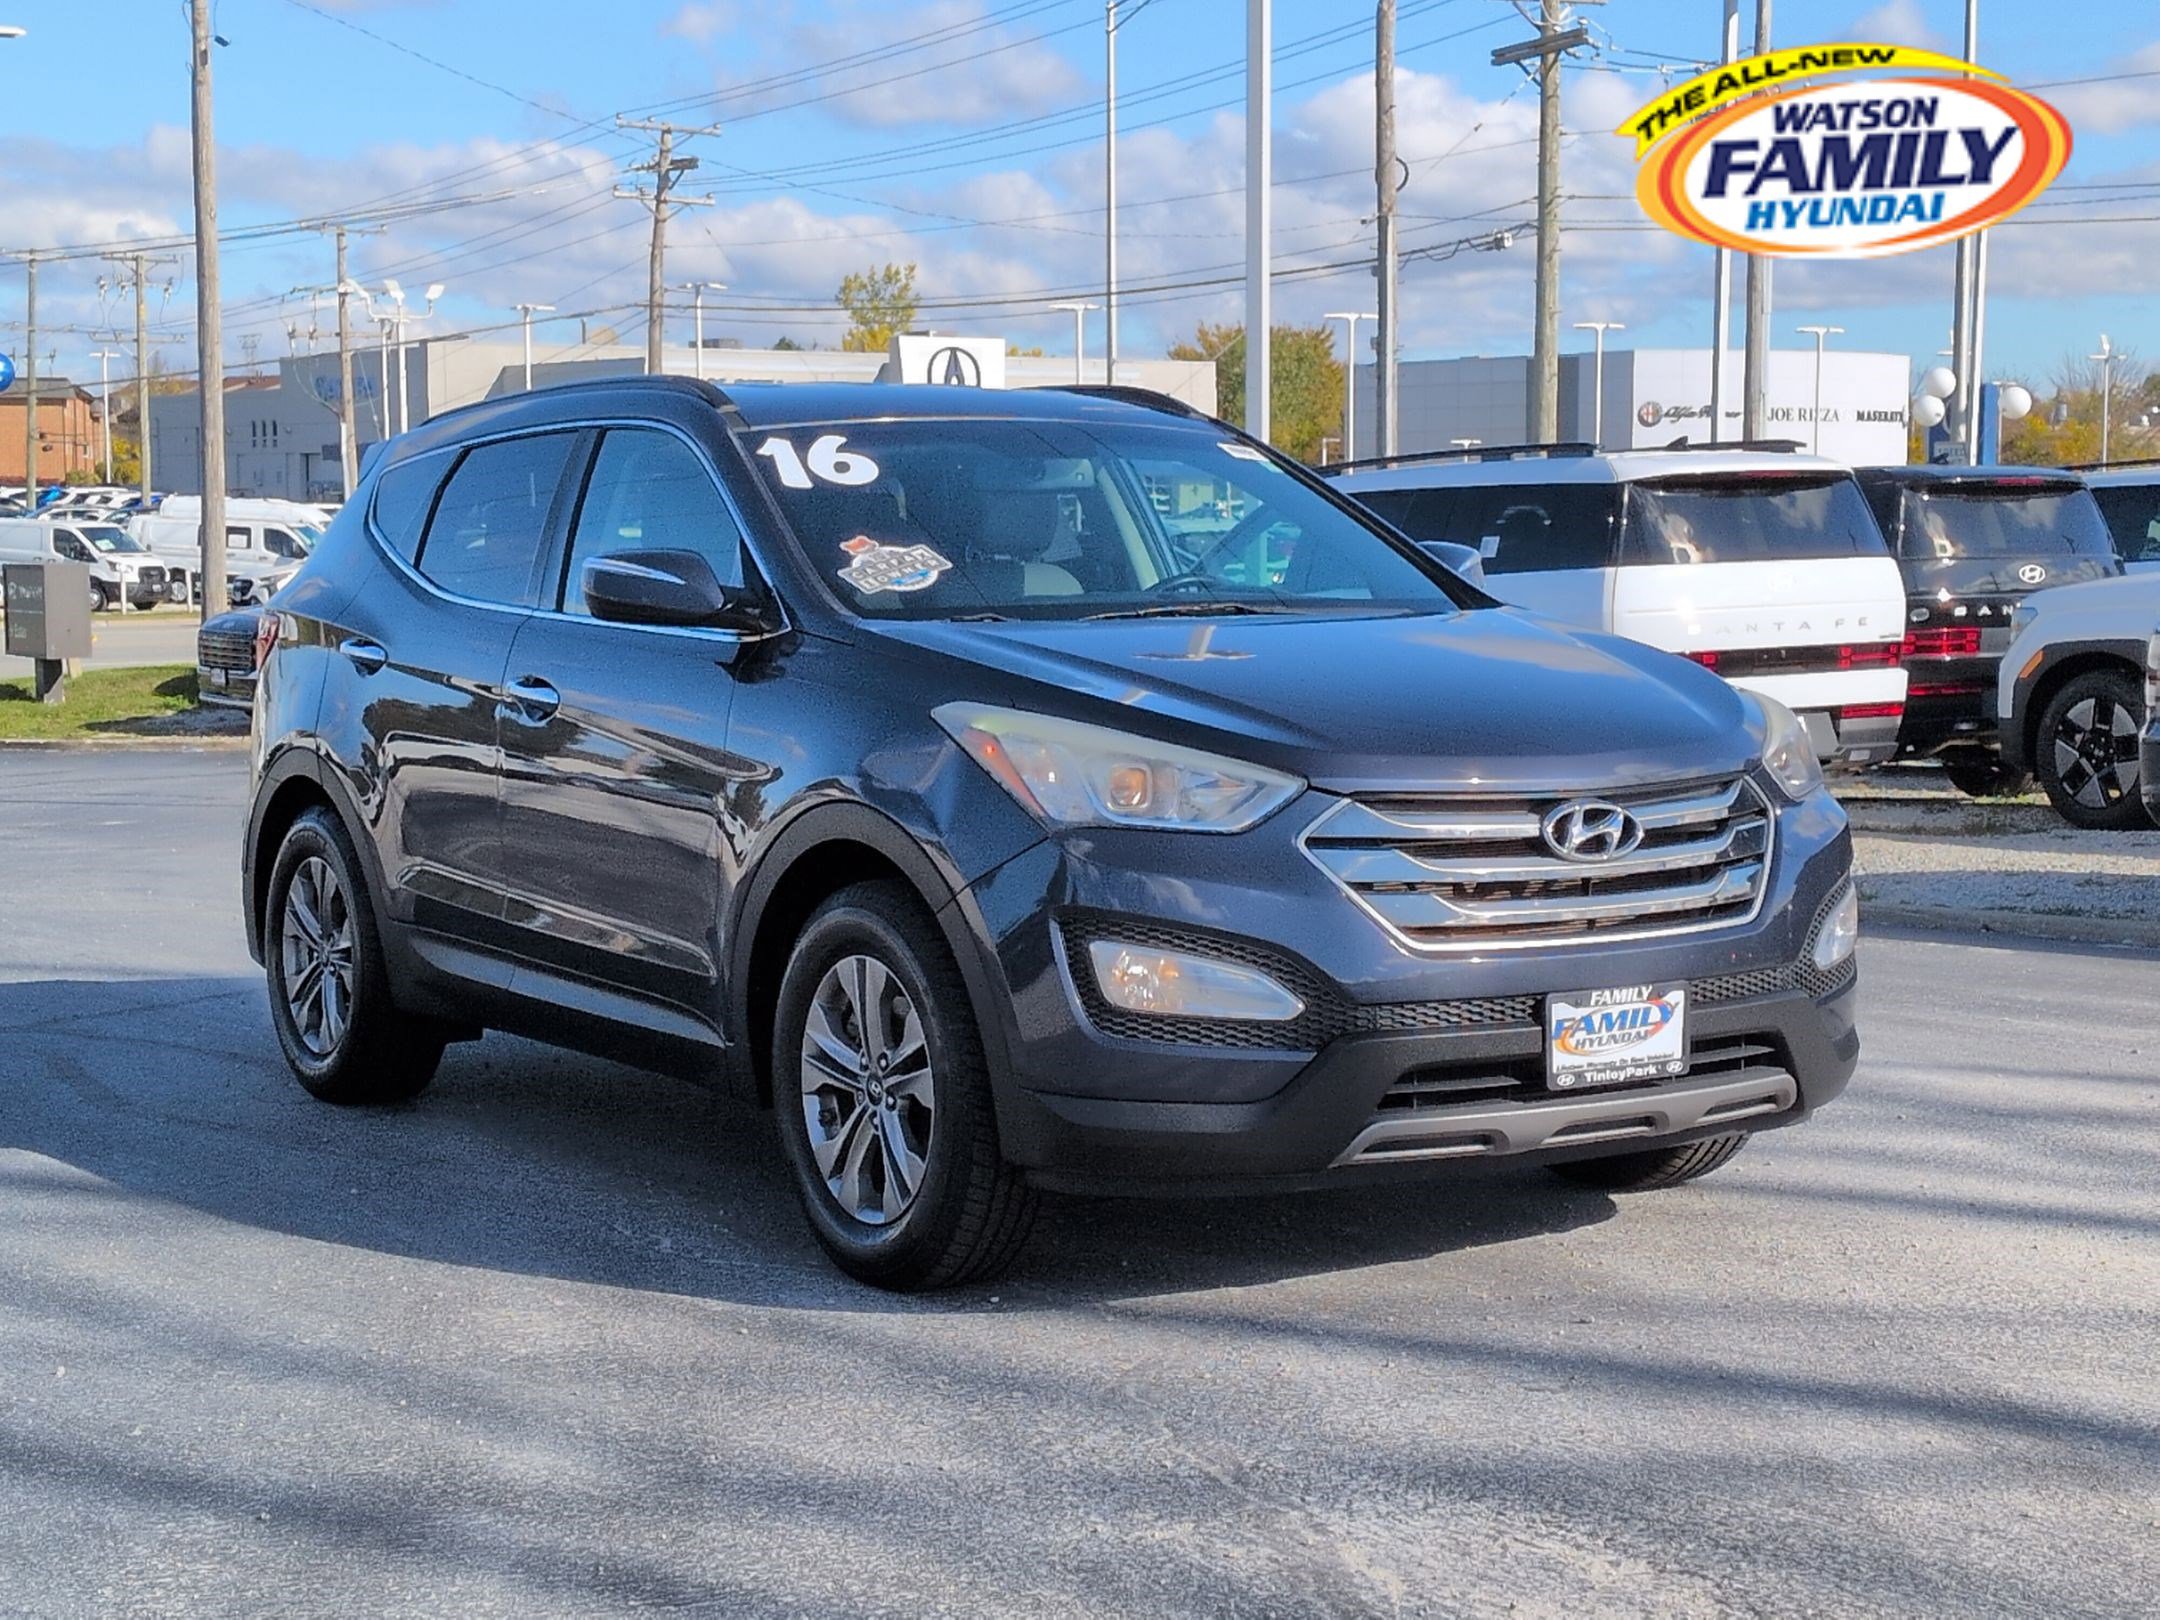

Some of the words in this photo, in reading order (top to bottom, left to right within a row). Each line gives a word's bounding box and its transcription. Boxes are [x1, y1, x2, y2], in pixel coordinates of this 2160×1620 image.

[1767, 407, 1794, 422] JOE
[756, 435, 879, 489] 16
[1834, 616, 1868, 629] FE
[1590, 985, 1652, 1006] FAMILY
[1552, 1001, 1681, 1040] FAMILY
[1575, 1029, 1648, 1050] HYUNDAI
